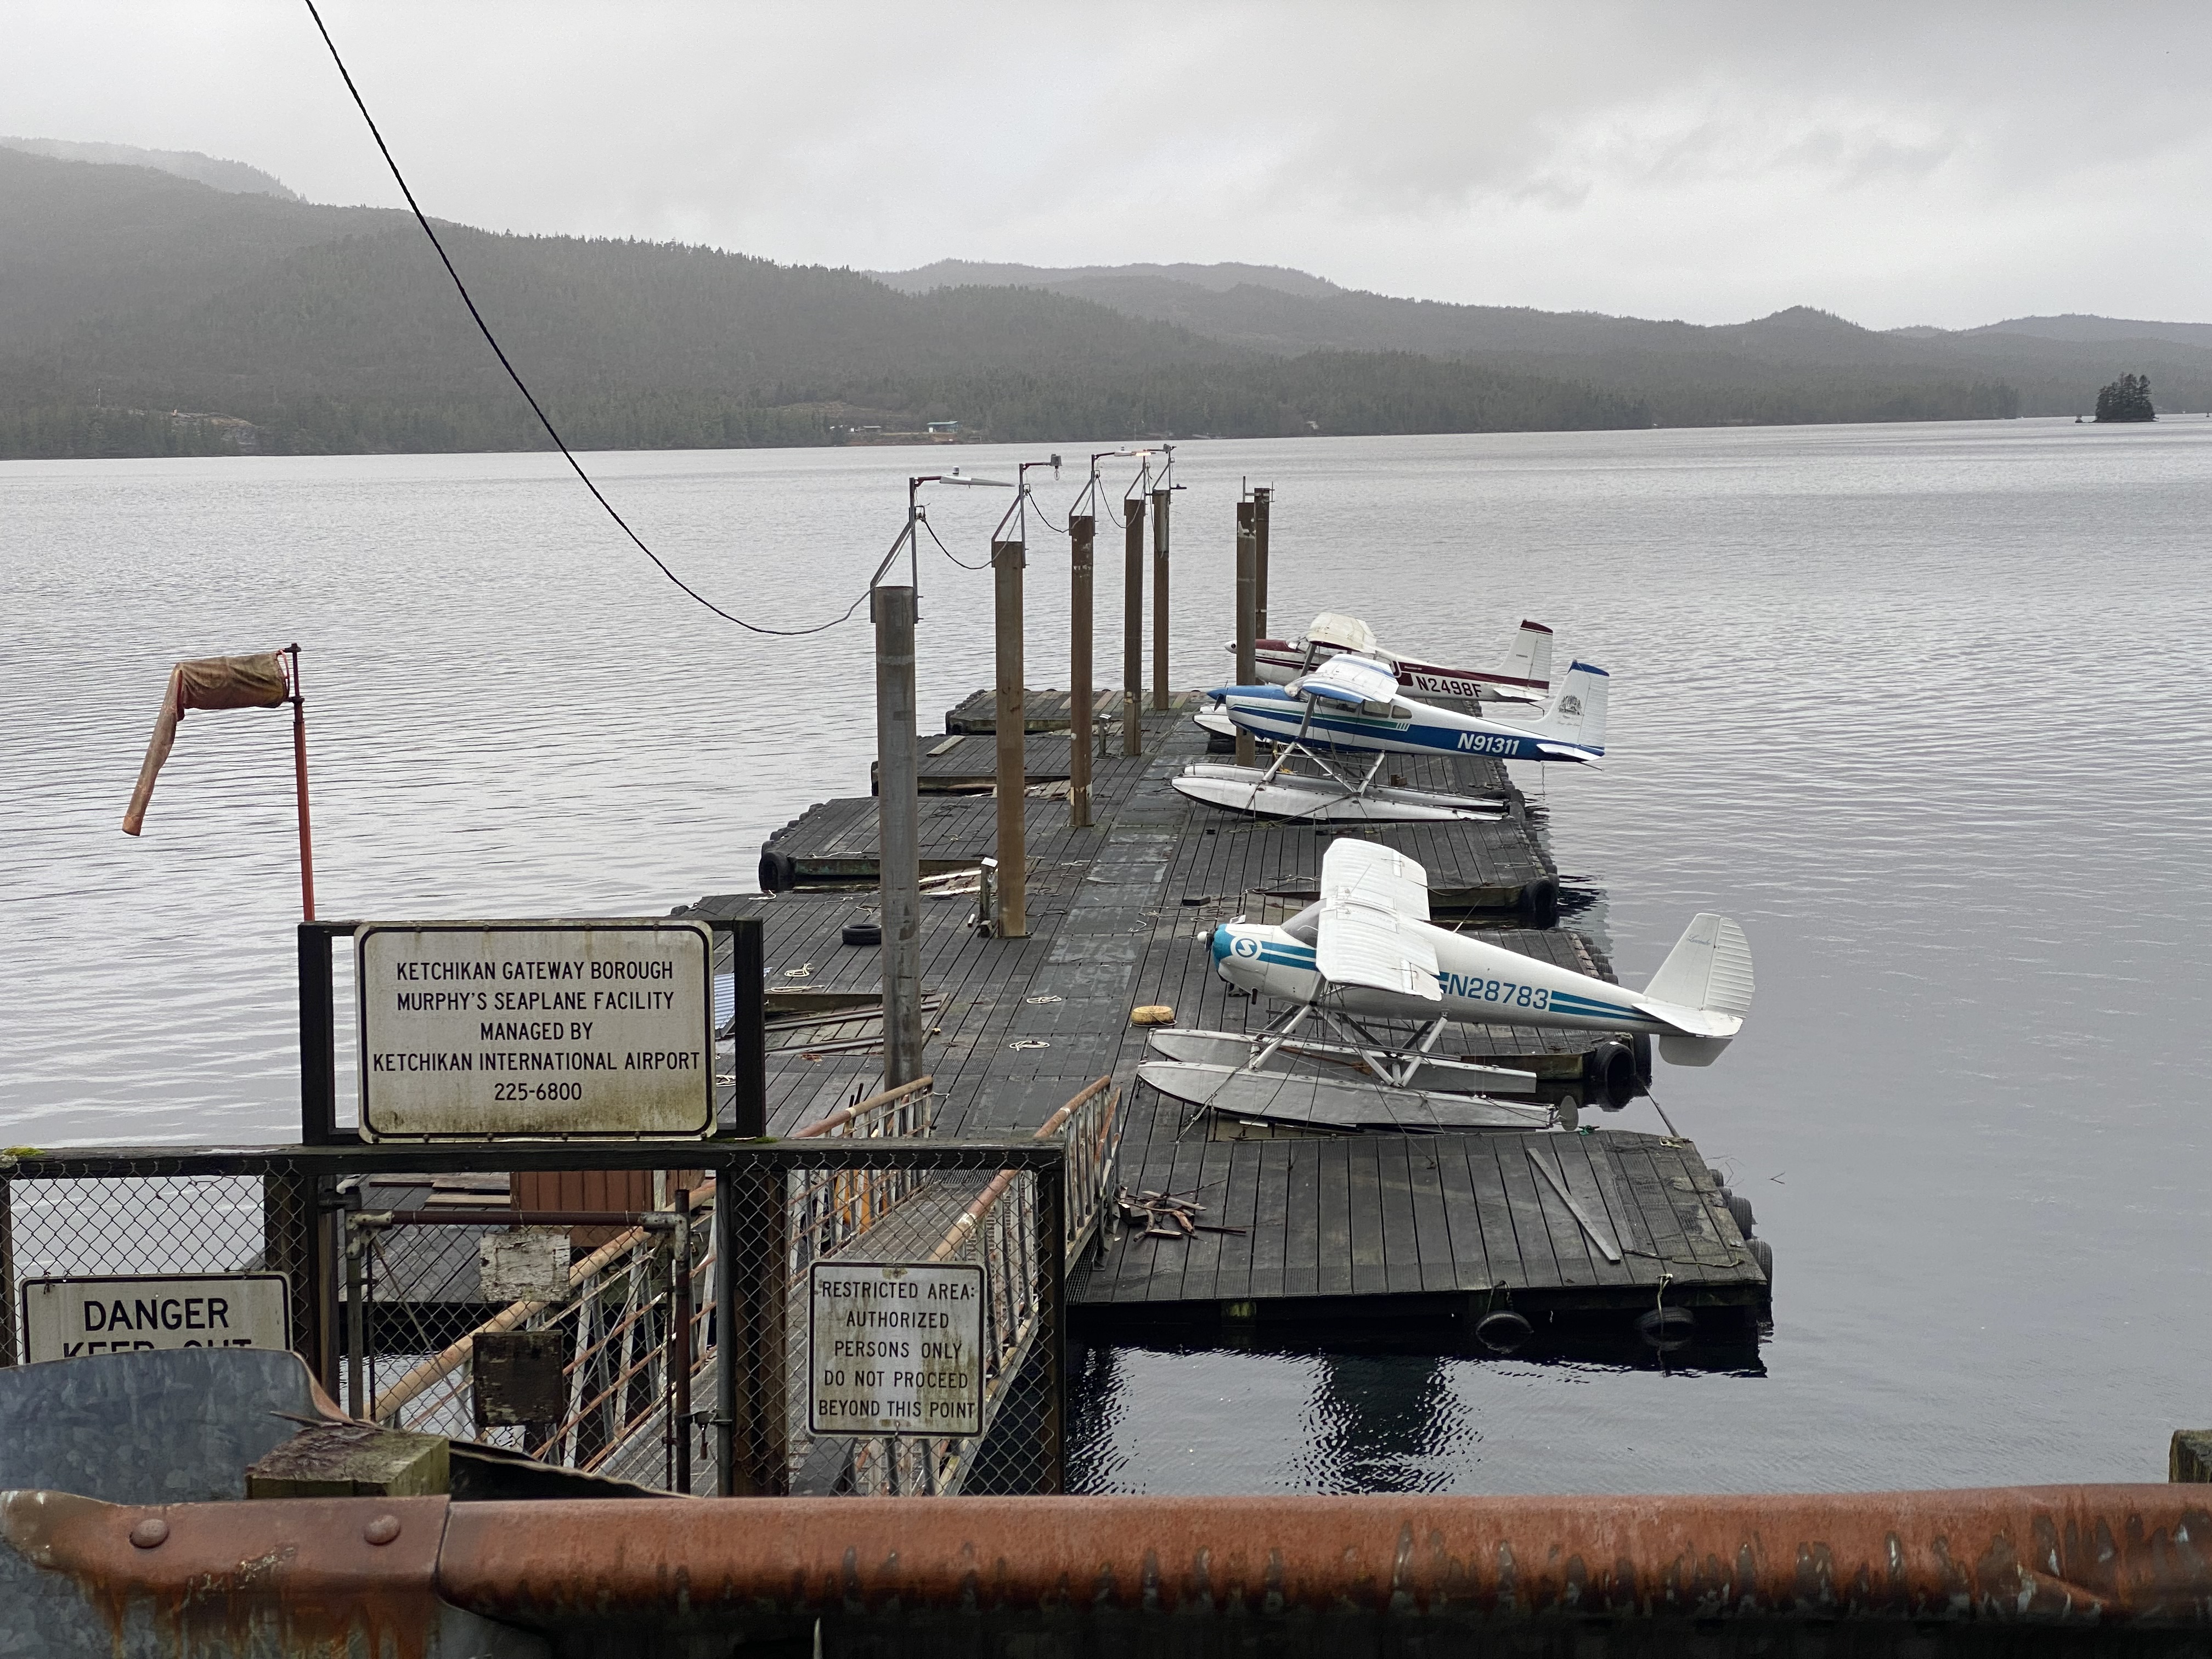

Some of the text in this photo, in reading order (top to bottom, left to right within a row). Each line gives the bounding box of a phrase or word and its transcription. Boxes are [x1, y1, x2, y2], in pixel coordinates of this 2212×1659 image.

[1415, 676, 1482, 697] N2498F
[1457, 733, 1520, 755] N91311
[397, 961, 673, 980] KETCHIKAN GATEWAY BOROUGH
[397, 991, 674, 1011] MURPHY'S SEAPLANE FACILITY
[1448, 974, 1549, 1010] N28783
[481, 1022, 593, 1040] MANAGED BY
[373, 1052, 700, 1071] KETCHIKAN INTERNATIONAL AIRPORT
[494, 1083, 582, 1101] 225-6800
[823, 1282, 975, 1300] RESTRICTED AREA:
[84, 1298, 228, 1331] DANGER
[846, 1311, 949, 1328] AUTHORIZED
[835, 1341, 962, 1359] PERSONS ONLY
[825, 1370, 968, 1388] DO NOT PROCEED
[819, 1400, 975, 1418] BEYOND THIS POINT
